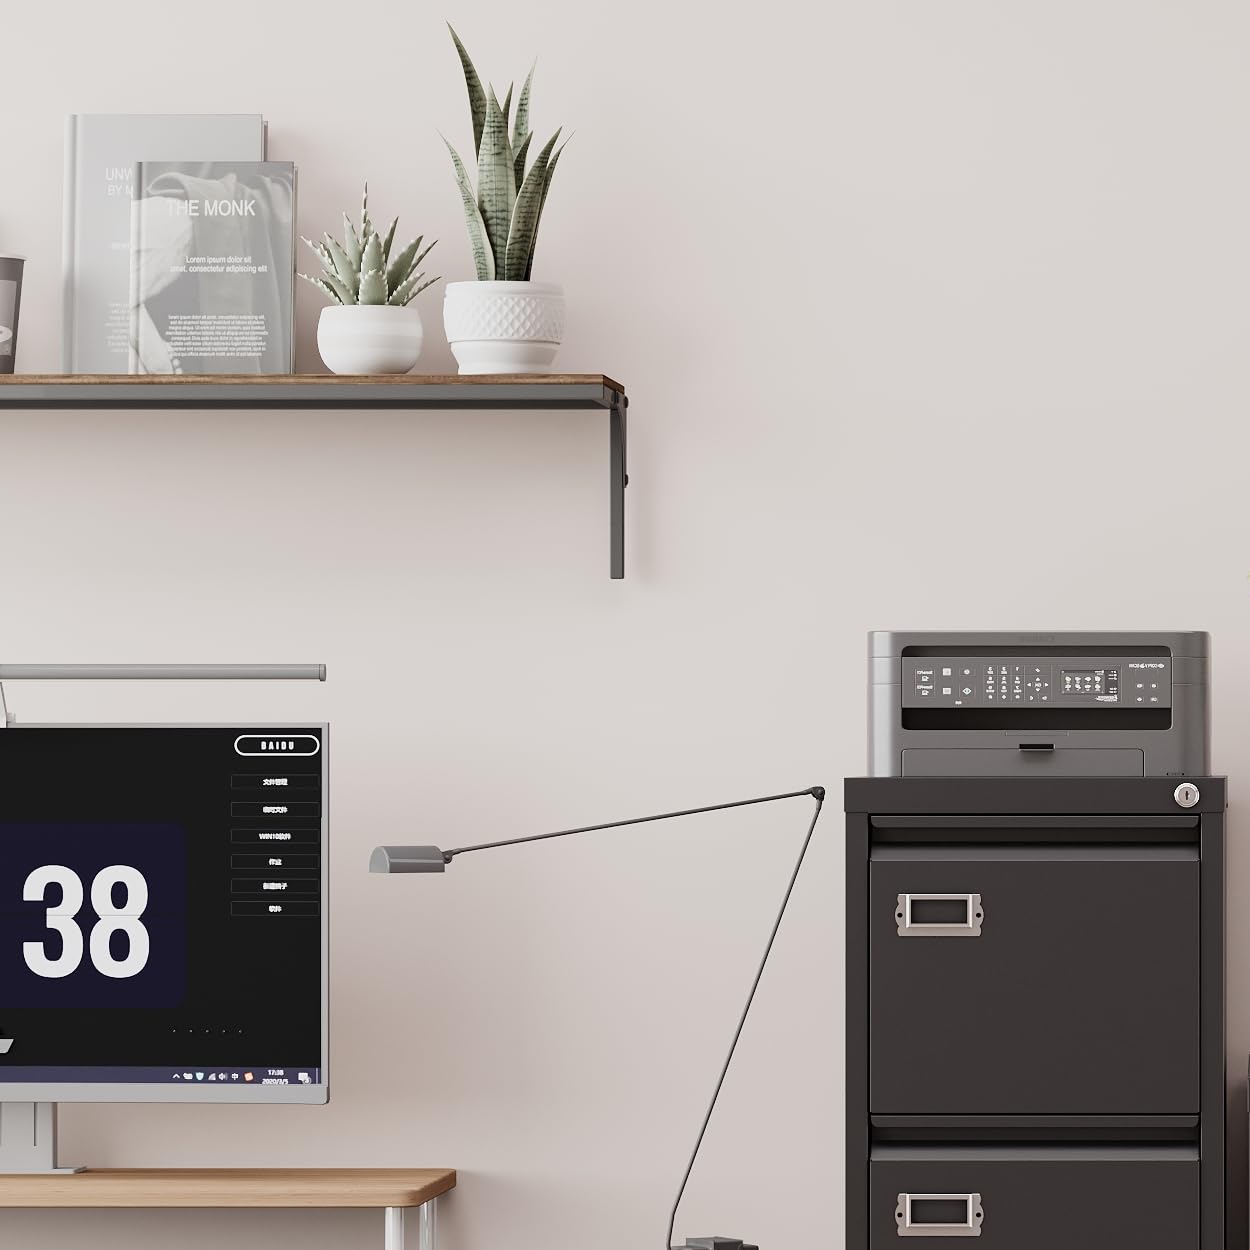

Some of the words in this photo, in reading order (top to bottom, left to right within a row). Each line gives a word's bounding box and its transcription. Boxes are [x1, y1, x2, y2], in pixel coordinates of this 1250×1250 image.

[167, 199, 200, 217] THE
[204, 199, 256, 217] MONK
[185, 255, 207, 264] Lorem
[207, 255, 226, 265] ipsum
[226, 255, 243, 264] dolor
[188, 264, 225, 273] consectetur
[225, 264, 257, 274] adipiscing
[260, 741, 295, 750] BAIDU
[23, 865, 150, 979] 38
